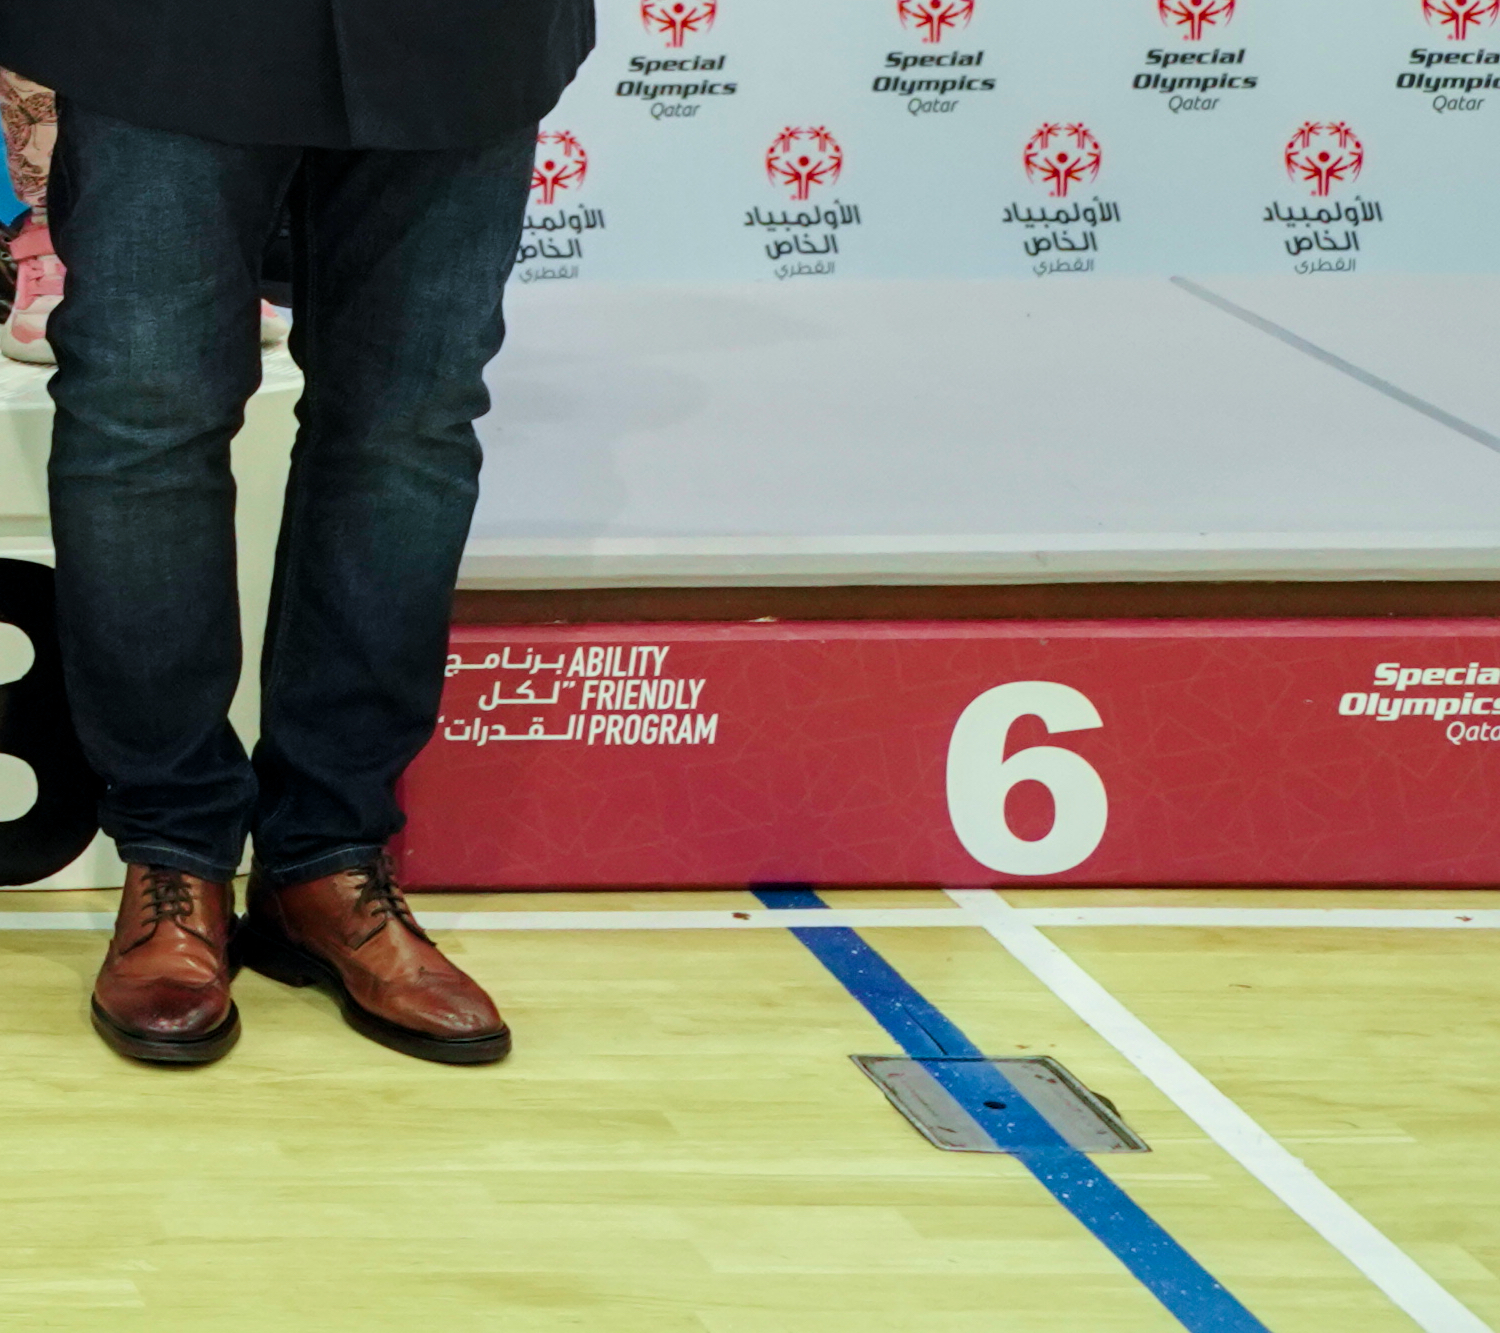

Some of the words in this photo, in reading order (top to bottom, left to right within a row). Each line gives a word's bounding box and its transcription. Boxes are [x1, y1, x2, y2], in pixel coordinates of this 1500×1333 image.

[628, 55, 726, 76] Special
[885, 50, 984, 72] Special
[615, 80, 737, 100] Olympics
[872, 75, 996, 96] Olympics
[650, 101, 701, 121] Qatar
[907, 97, 959, 117] Qatar
[1263, 195, 1383, 228] الأولمبياد
[1285, 230, 1360, 256] الخاص
[566, 645, 670, 678] ABILITY
[1373, 661, 1500, 691] Specia
[580, 678, 707, 711] FRIENDLY
[587, 713, 719, 746] PROGRAM
[1445, 720, 1500, 746] Qata
[946, 681, 1108, 875] 6
